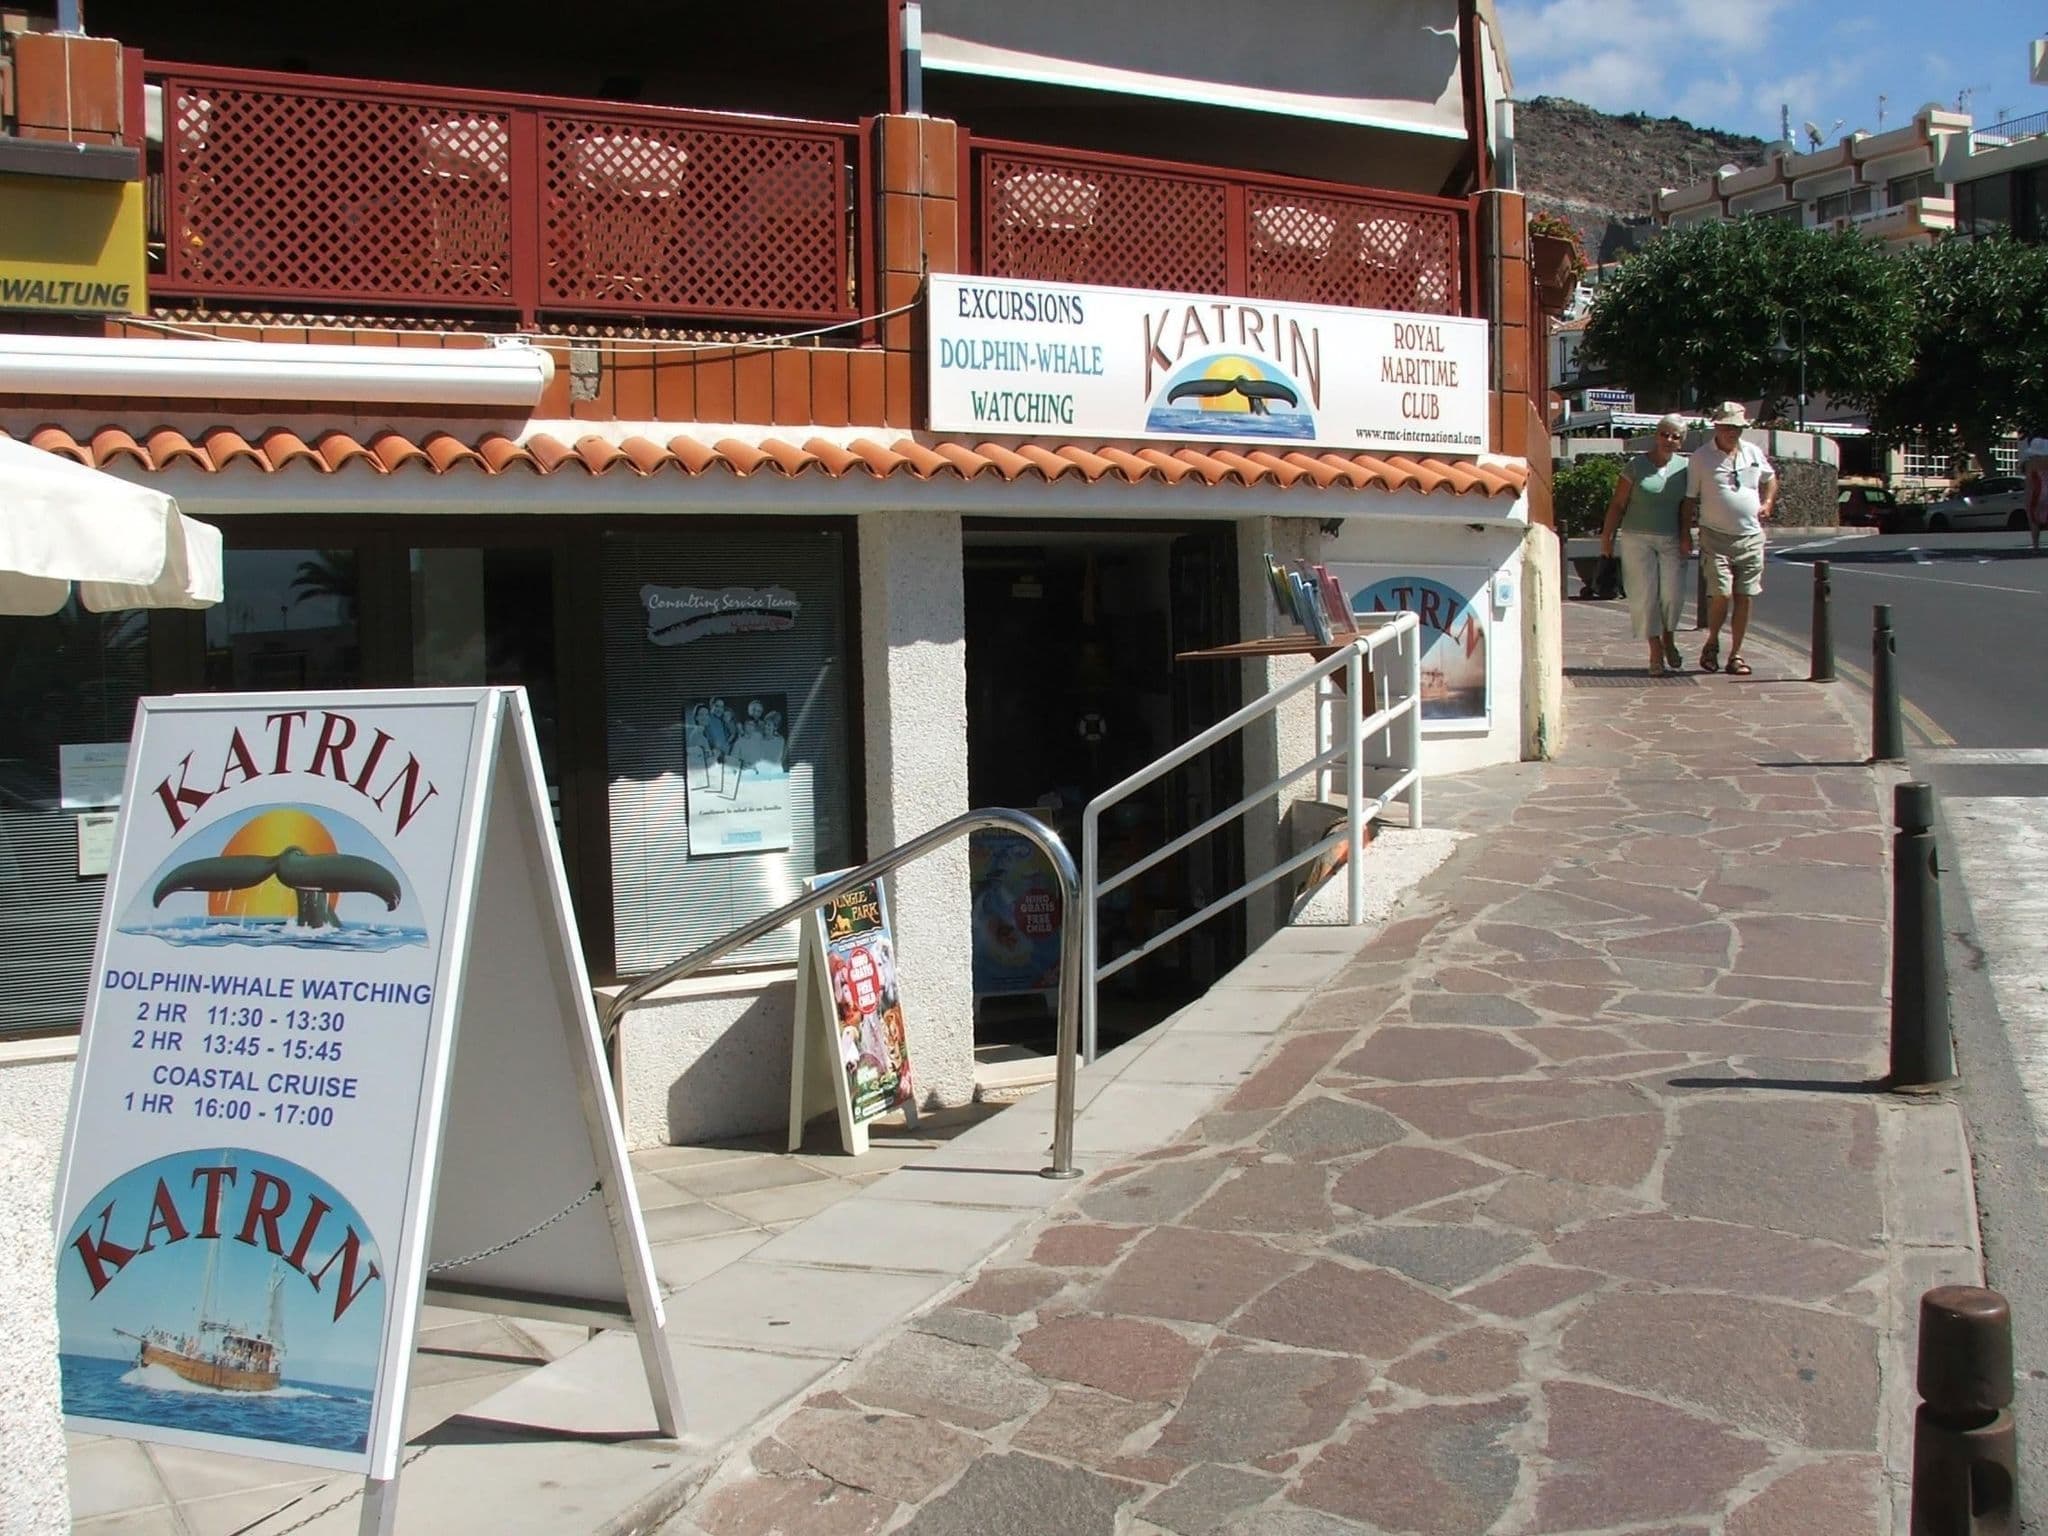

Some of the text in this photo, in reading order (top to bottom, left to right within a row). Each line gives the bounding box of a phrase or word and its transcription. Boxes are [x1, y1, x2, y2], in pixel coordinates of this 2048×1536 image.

[0, 277, 130, 307] WALTUNG
[958, 287, 1084, 325] EXCURSIONS
[1393, 322, 1445, 353] ROYAL
[940, 337, 1104, 376] DOLPHIN-WHALE
[1143, 304, 1321, 411] KATRIN
[1381, 356, 1458, 388] MARITIME
[971, 390, 1074, 425] WATCHING
[1401, 392, 1440, 420] CLUB
[1355, 427, 1482, 446] www.rmc-international.com
[648, 593, 797, 614] Consulting Service Team
[152, 710, 439, 838] KATRIN
[851, 902, 881, 924] PARK
[104, 970, 432, 1005] DOLPHIN-WHALE WATCHING
[137, 1002, 150, 1021] 2
[156, 1003, 187, 1023] HR
[207, 1006, 263, 1027] 11:30
[285, 1010, 345, 1033] 13:30
[132, 1030, 145, 1049] 2
[152, 1031, 183, 1051] HR
[203, 1035, 260, 1057] 13:45
[282, 1039, 342, 1062] 15:45
[153, 1065, 358, 1099] COASTAL CRUISE
[124, 1092, 135, 1111] 1
[142, 1094, 174, 1114] HR
[194, 1098, 251, 1121] 16:00
[274, 1103, 333, 1127] 17:00
[70, 1166, 381, 1324] KATRIN
